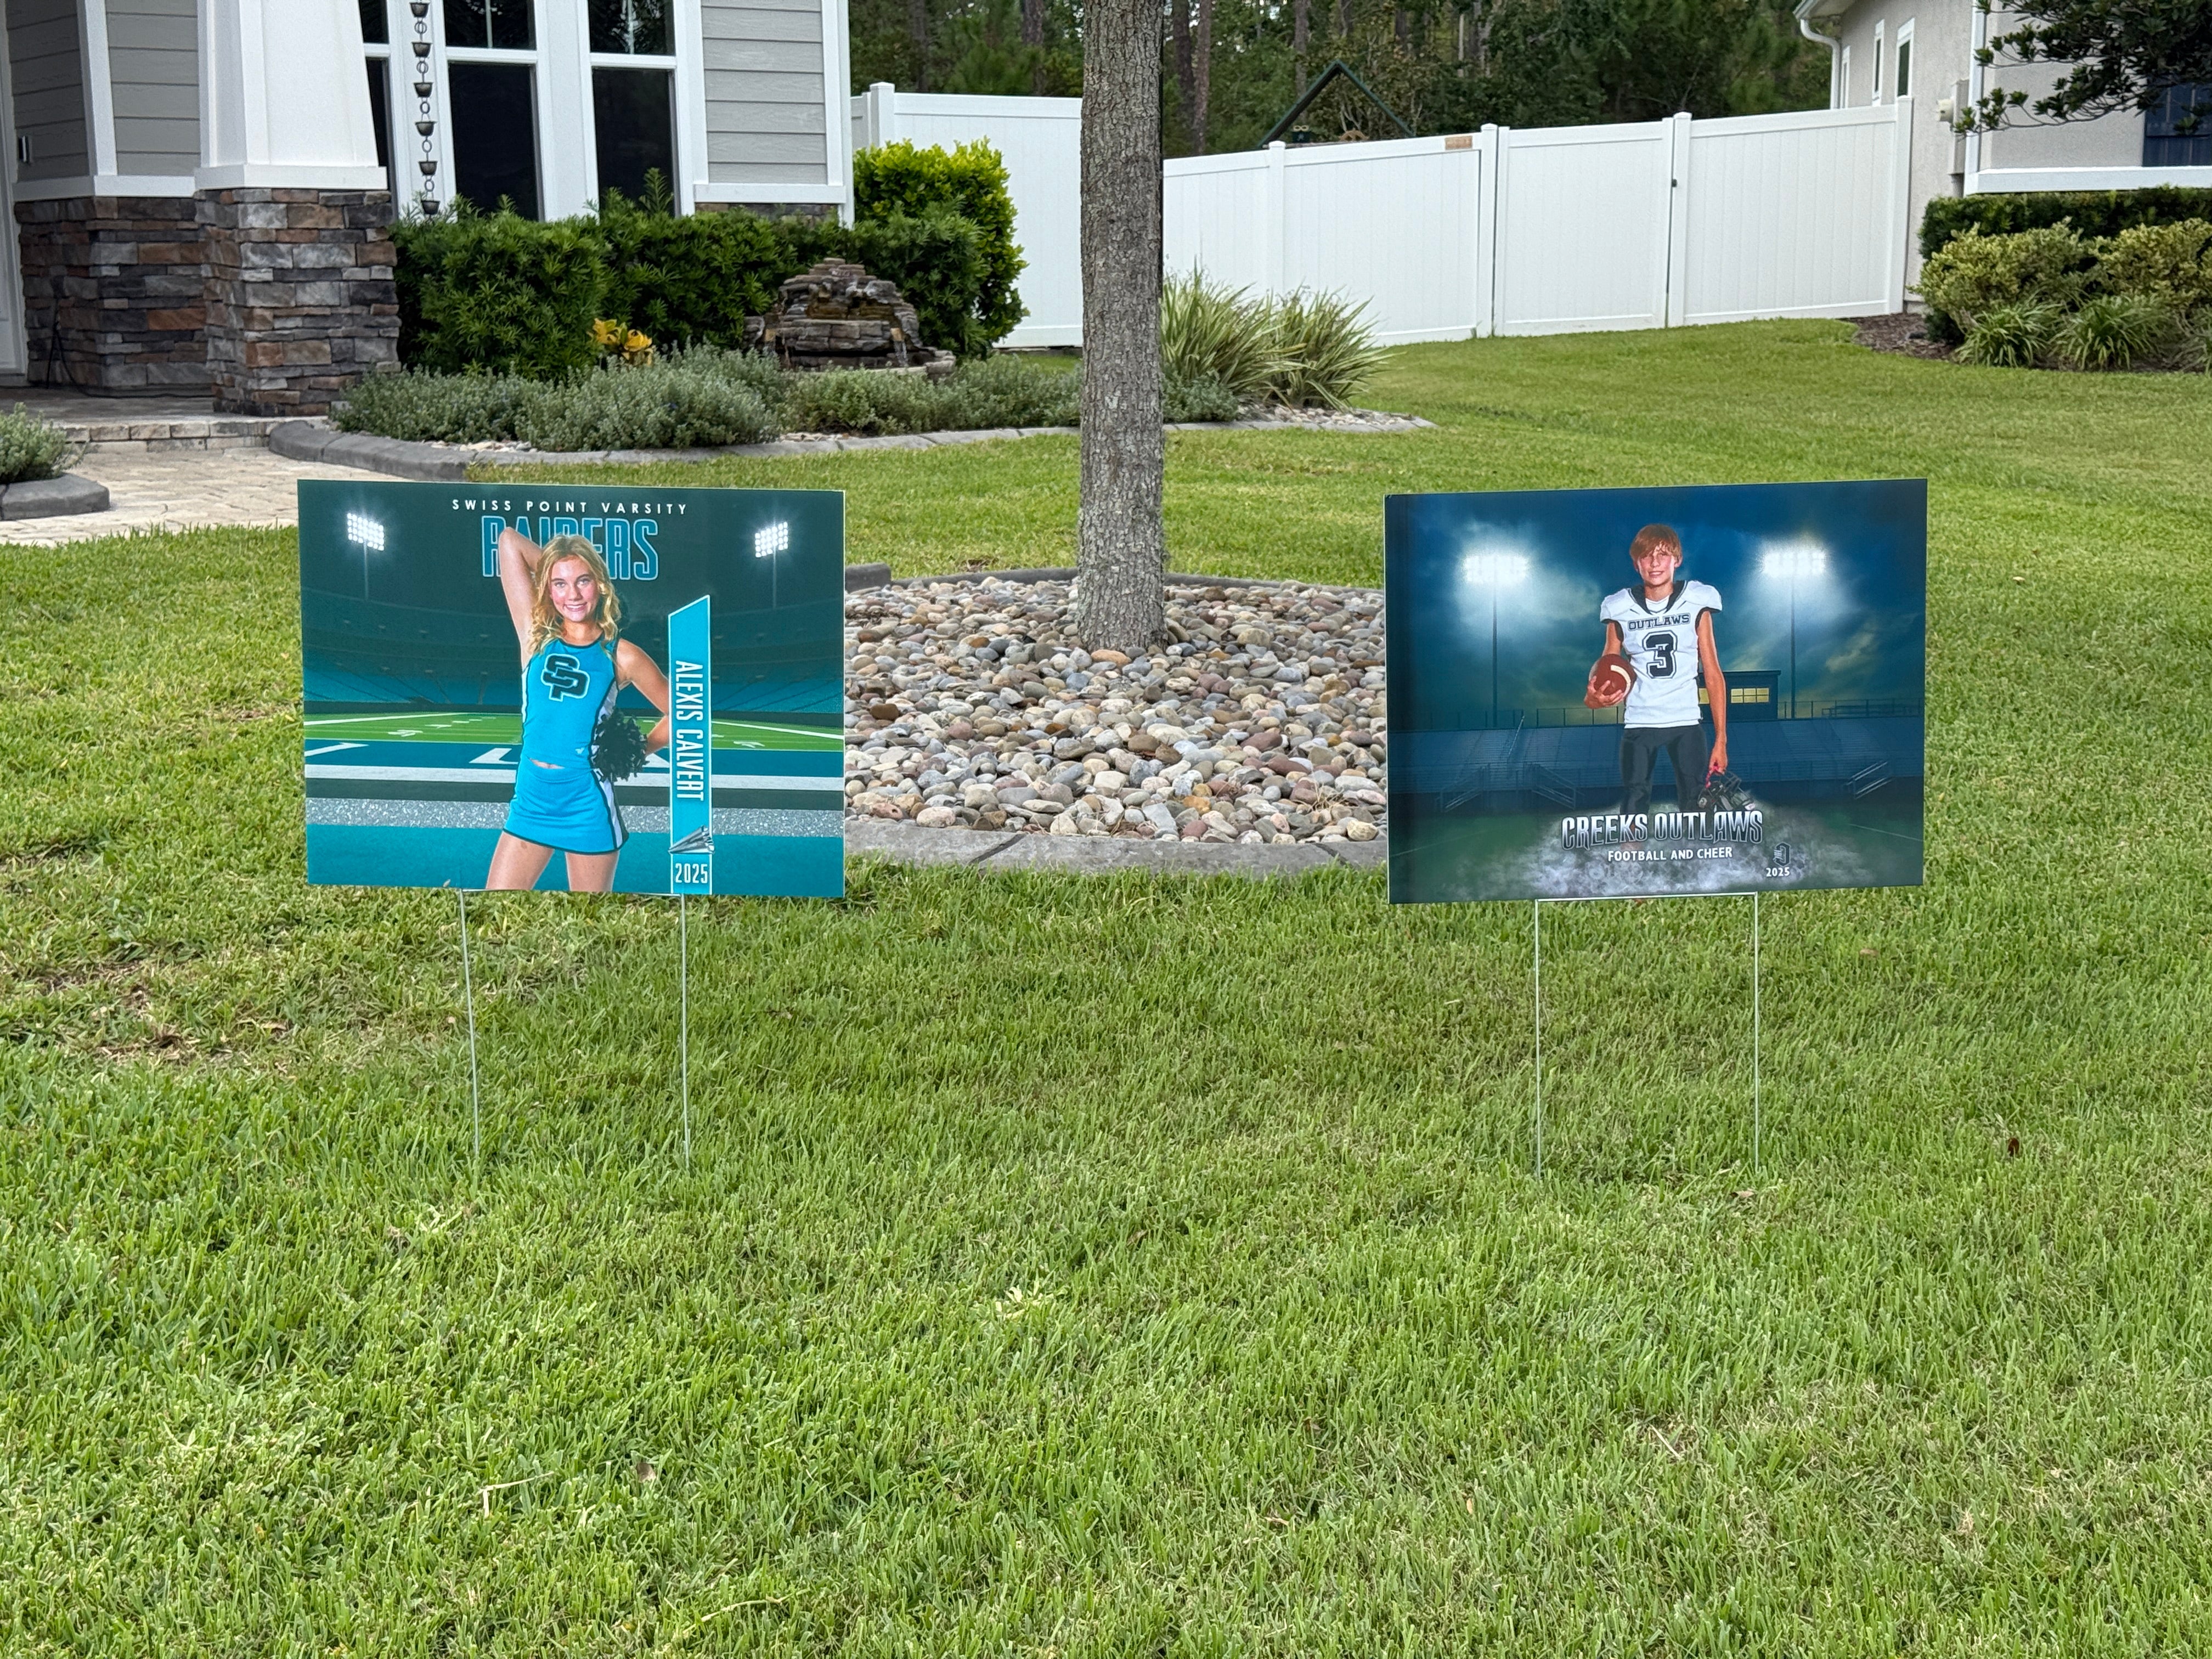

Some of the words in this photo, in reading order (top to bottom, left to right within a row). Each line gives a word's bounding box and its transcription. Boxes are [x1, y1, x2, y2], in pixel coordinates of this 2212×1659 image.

[452, 499, 512, 512] SWISS
[526, 500, 588, 513] POINT
[601, 502, 687, 515] VARSITY
[1628, 613, 1691, 631] OUTLAWS
[1642, 630, 1678, 679] 3
[675, 660, 704, 721] ALEXIS
[675, 729, 704, 802] CALVERT
[1561, 813, 1648, 851] CREEKS
[1654, 810, 1763, 844] OUTLAWS
[1608, 850, 1667, 862] FOOTBALL
[1671, 849, 1694, 860] AND
[1697, 847, 1733, 859] CHEER
[675, 863, 708, 884] 2025
[1765, 866, 1791, 877] 2025
